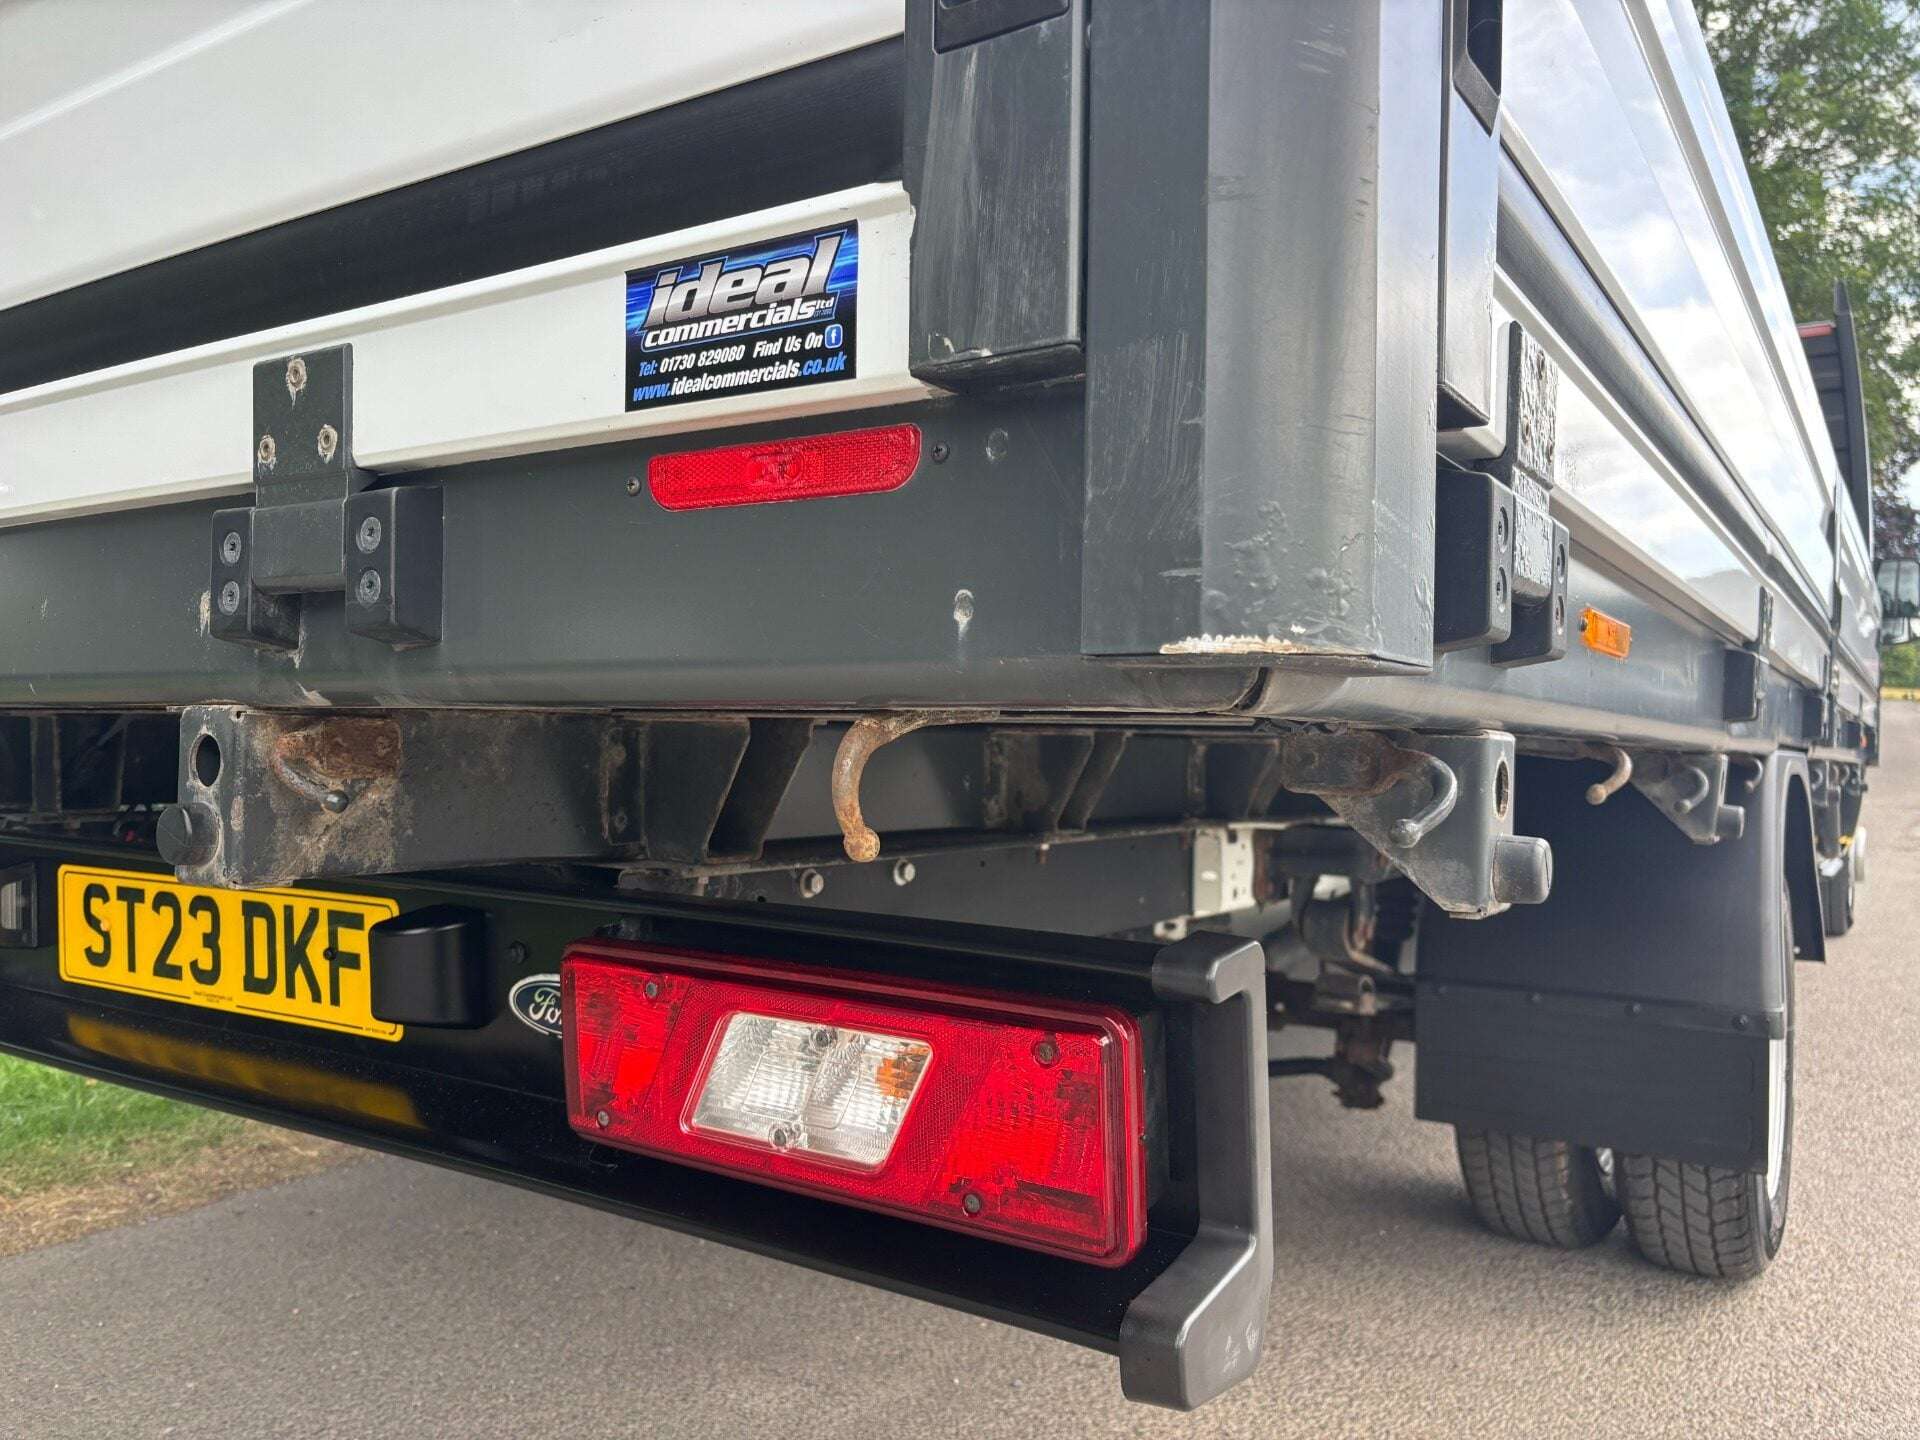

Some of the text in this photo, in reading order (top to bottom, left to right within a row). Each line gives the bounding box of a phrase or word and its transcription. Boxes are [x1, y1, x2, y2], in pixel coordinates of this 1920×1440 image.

[644, 235, 842, 327] ideal
[644, 298, 816, 347] commercials
[633, 352, 846, 402] www.idealcommercials.co.uk
[639, 360, 657, 376] Tel:
[660, 353, 696, 373] 01730
[698, 344, 745, 366] 829080
[753, 340, 782, 358] Find
[785, 335, 801, 352] Us
[805, 332, 823, 349] On
[83, 883, 364, 1007] ST23 DKF
